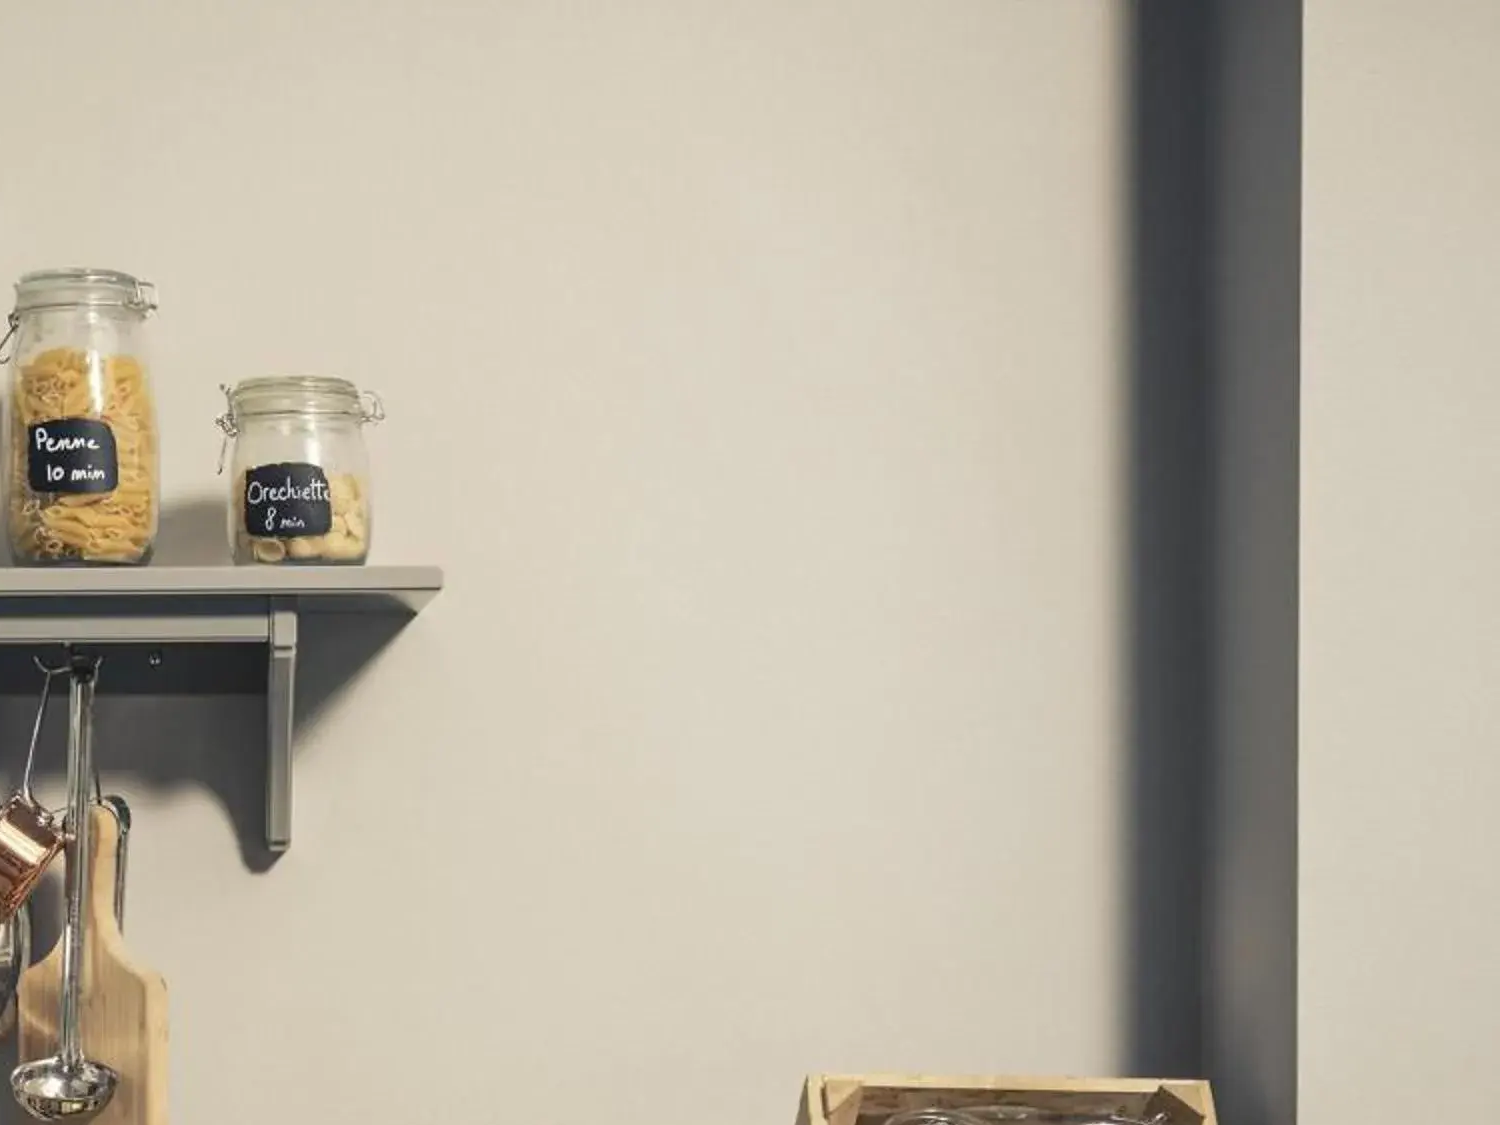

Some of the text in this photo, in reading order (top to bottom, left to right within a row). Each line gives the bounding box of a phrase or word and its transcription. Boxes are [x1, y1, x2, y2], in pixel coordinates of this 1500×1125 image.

[35, 427, 101, 452] Penne
[46, 463, 106, 483] 10 min
[265, 507, 305, 531] 8 min
